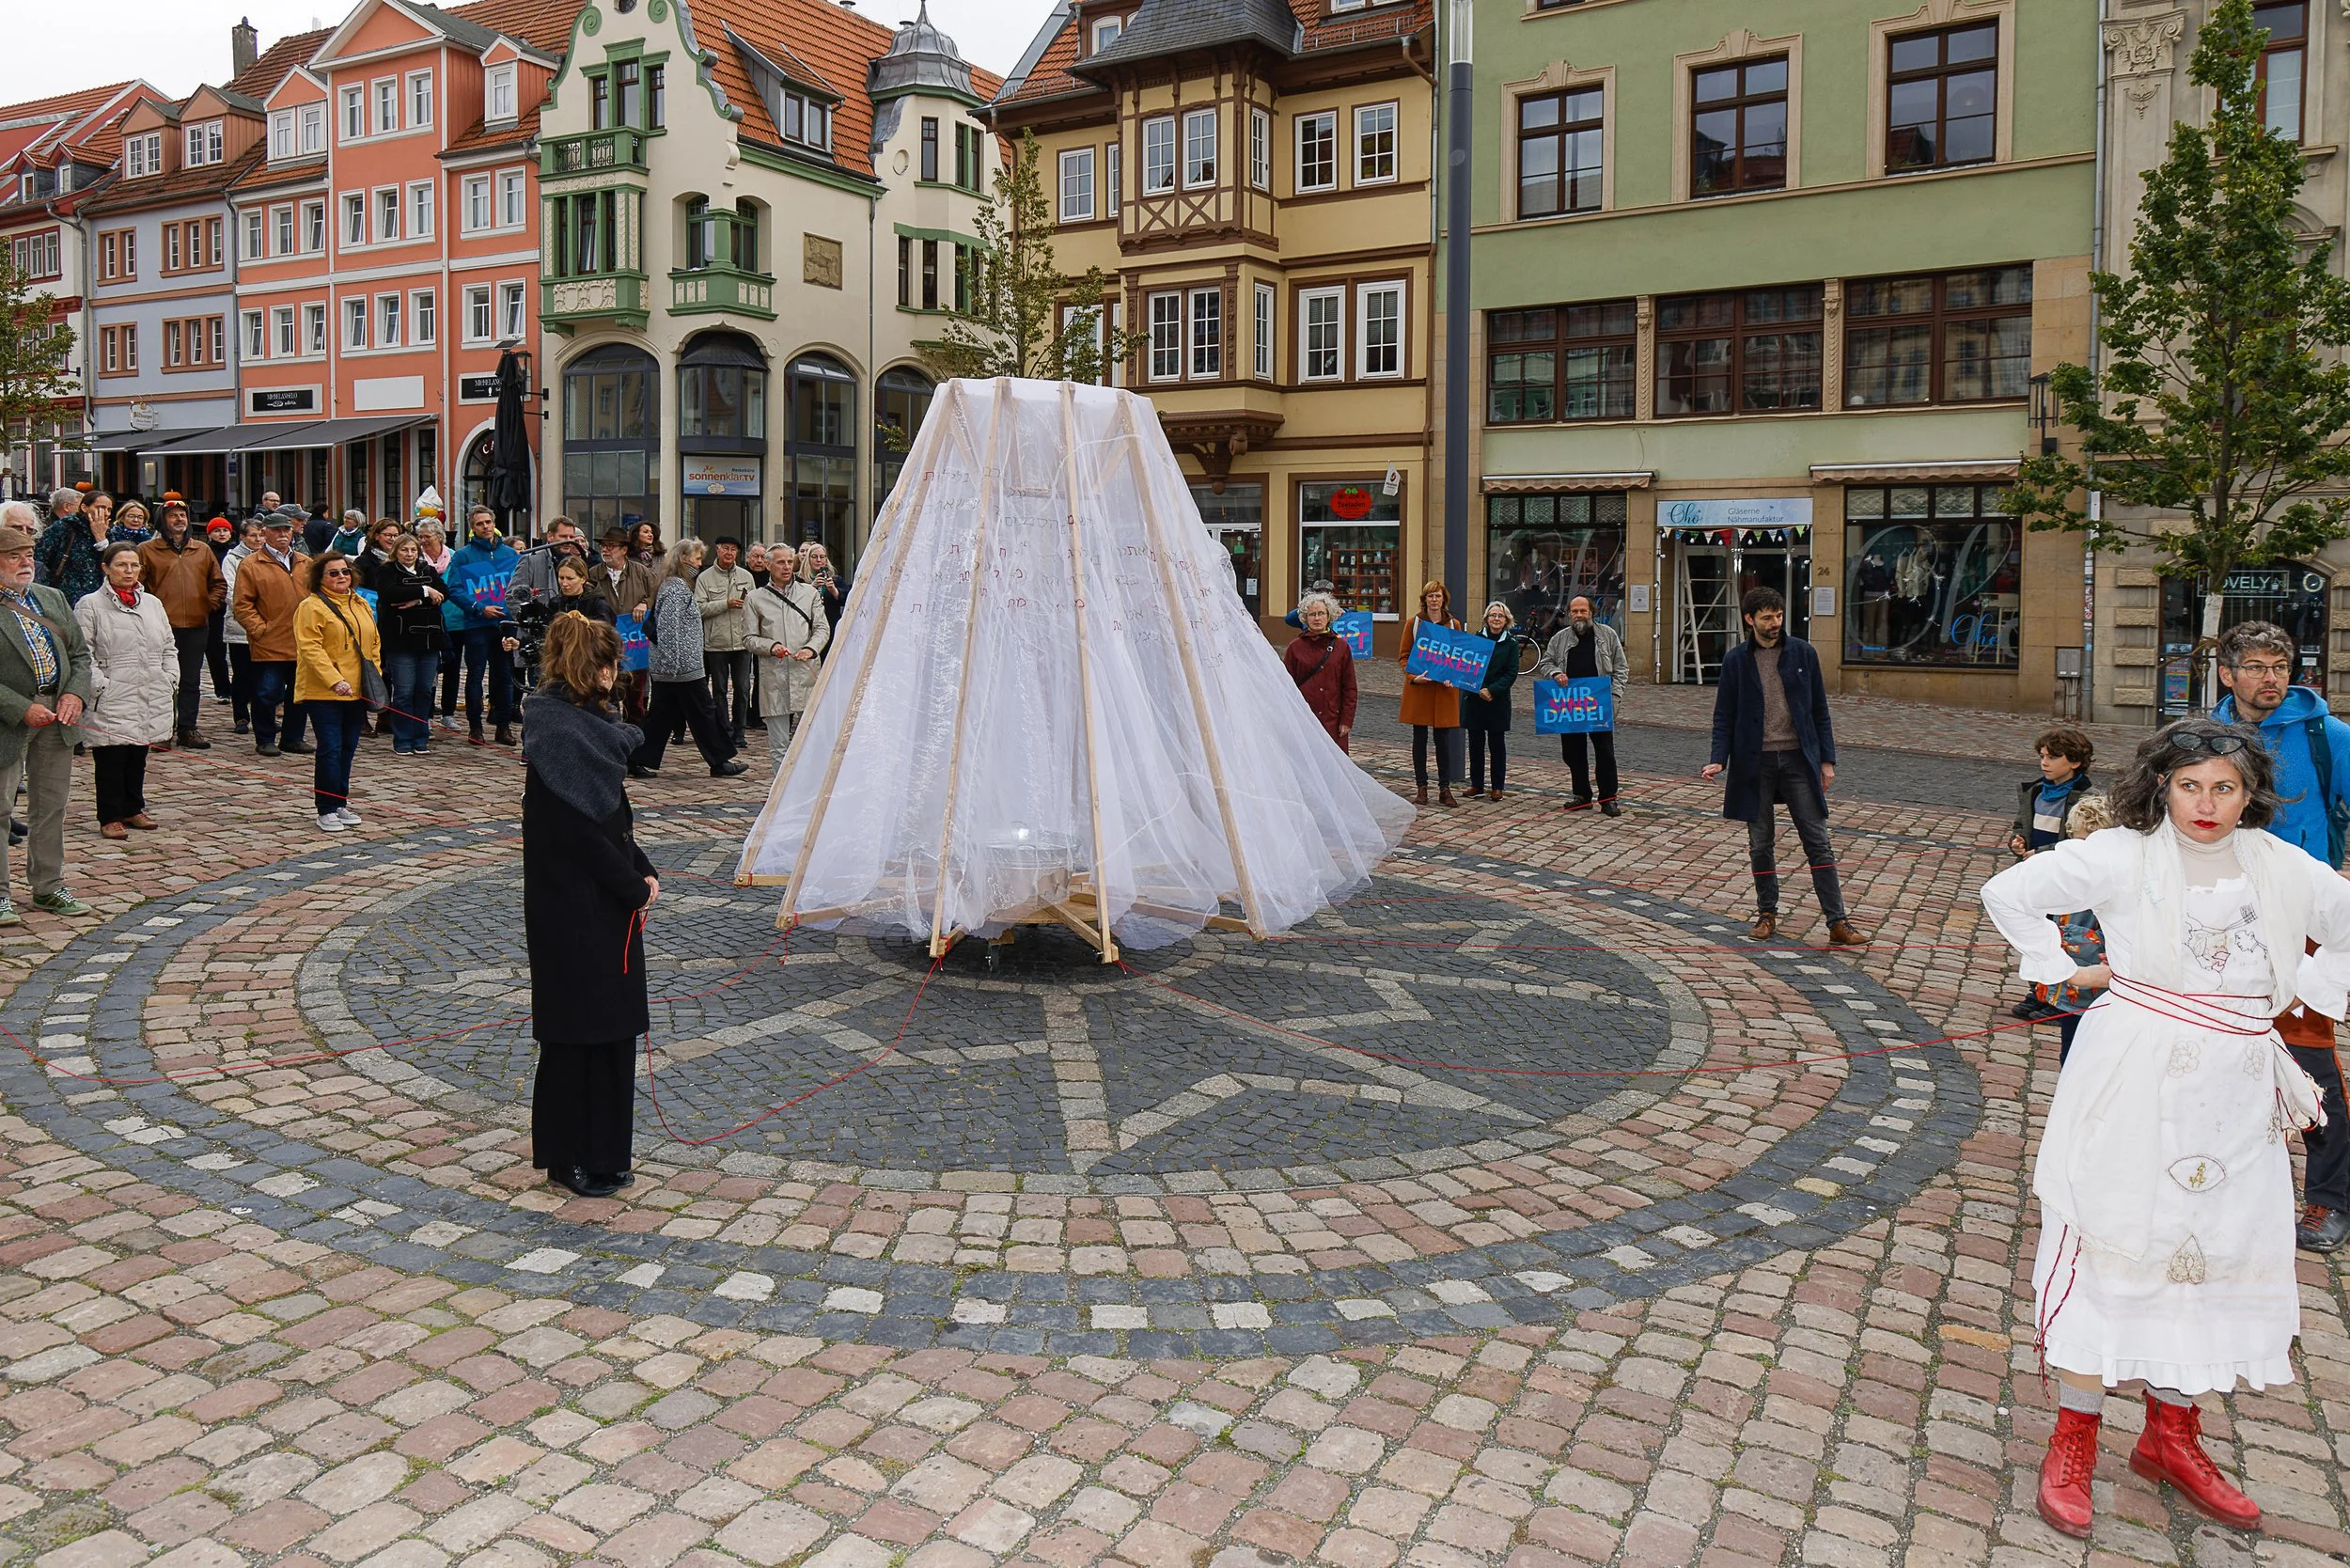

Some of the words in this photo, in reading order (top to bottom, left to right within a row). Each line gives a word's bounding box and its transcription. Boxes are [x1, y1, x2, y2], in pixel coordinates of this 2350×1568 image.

[688, 472, 755, 482] sonnenklar.TV
[1817, 567, 1830, 576] 24
[1416, 636, 1488, 668] GERECH
[1551, 686, 1594, 703] WIR
[1548, 697, 1598, 713] SIND
[1543, 705, 1604, 724] DABEI
